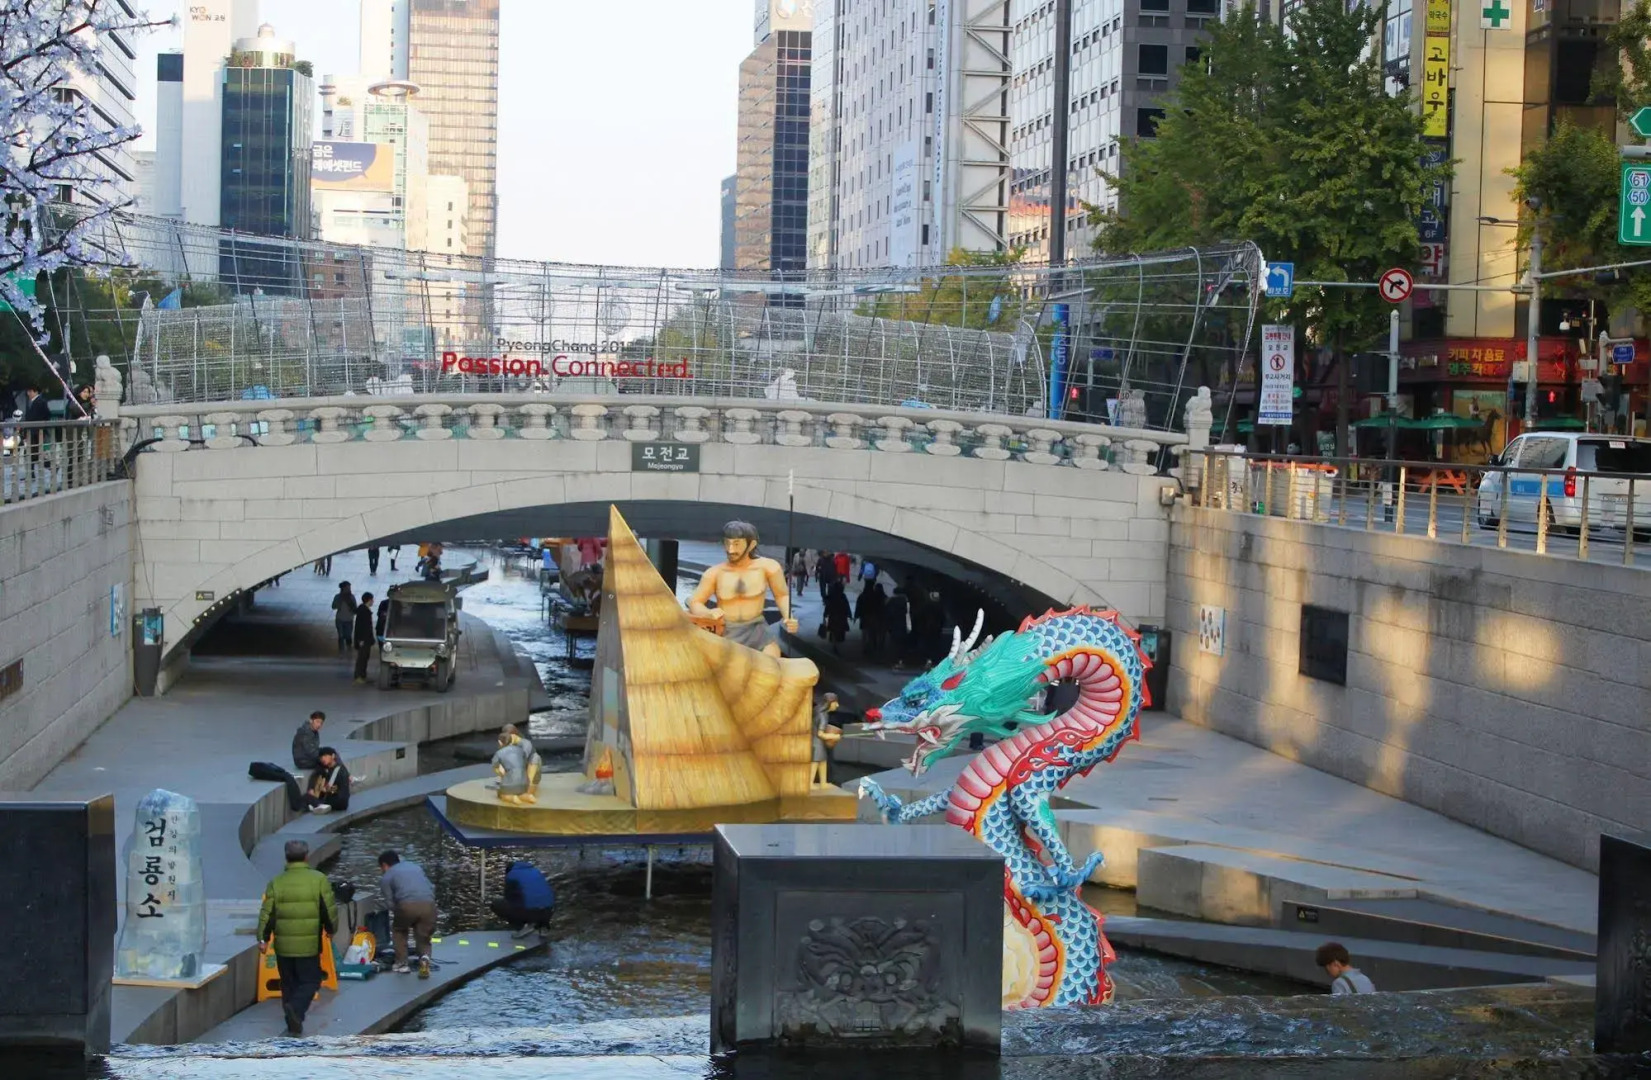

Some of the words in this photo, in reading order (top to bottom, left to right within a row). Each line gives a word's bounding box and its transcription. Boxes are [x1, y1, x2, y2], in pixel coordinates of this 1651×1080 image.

[190, 6, 206, 14] KYO
[1426, 46, 1446, 111] 고바우
[313, 145, 333, 158] 금은
[1633, 176, 1646, 186] 61
[1632, 191, 1645, 202] 50
[1425, 230, 1437, 238] 6F
[1268, 287, 1288, 295] 비보호
[497, 338, 597, 354] PyeongChang
[1448, 348, 1469, 361] 커피
[1484, 348, 1505, 362] 음료
[443, 351, 549, 377] Passion.
[552, 354, 694, 378] Connected.
[642, 446, 689, 461] 모전교
[136, 818, 167, 918] 검룡소
